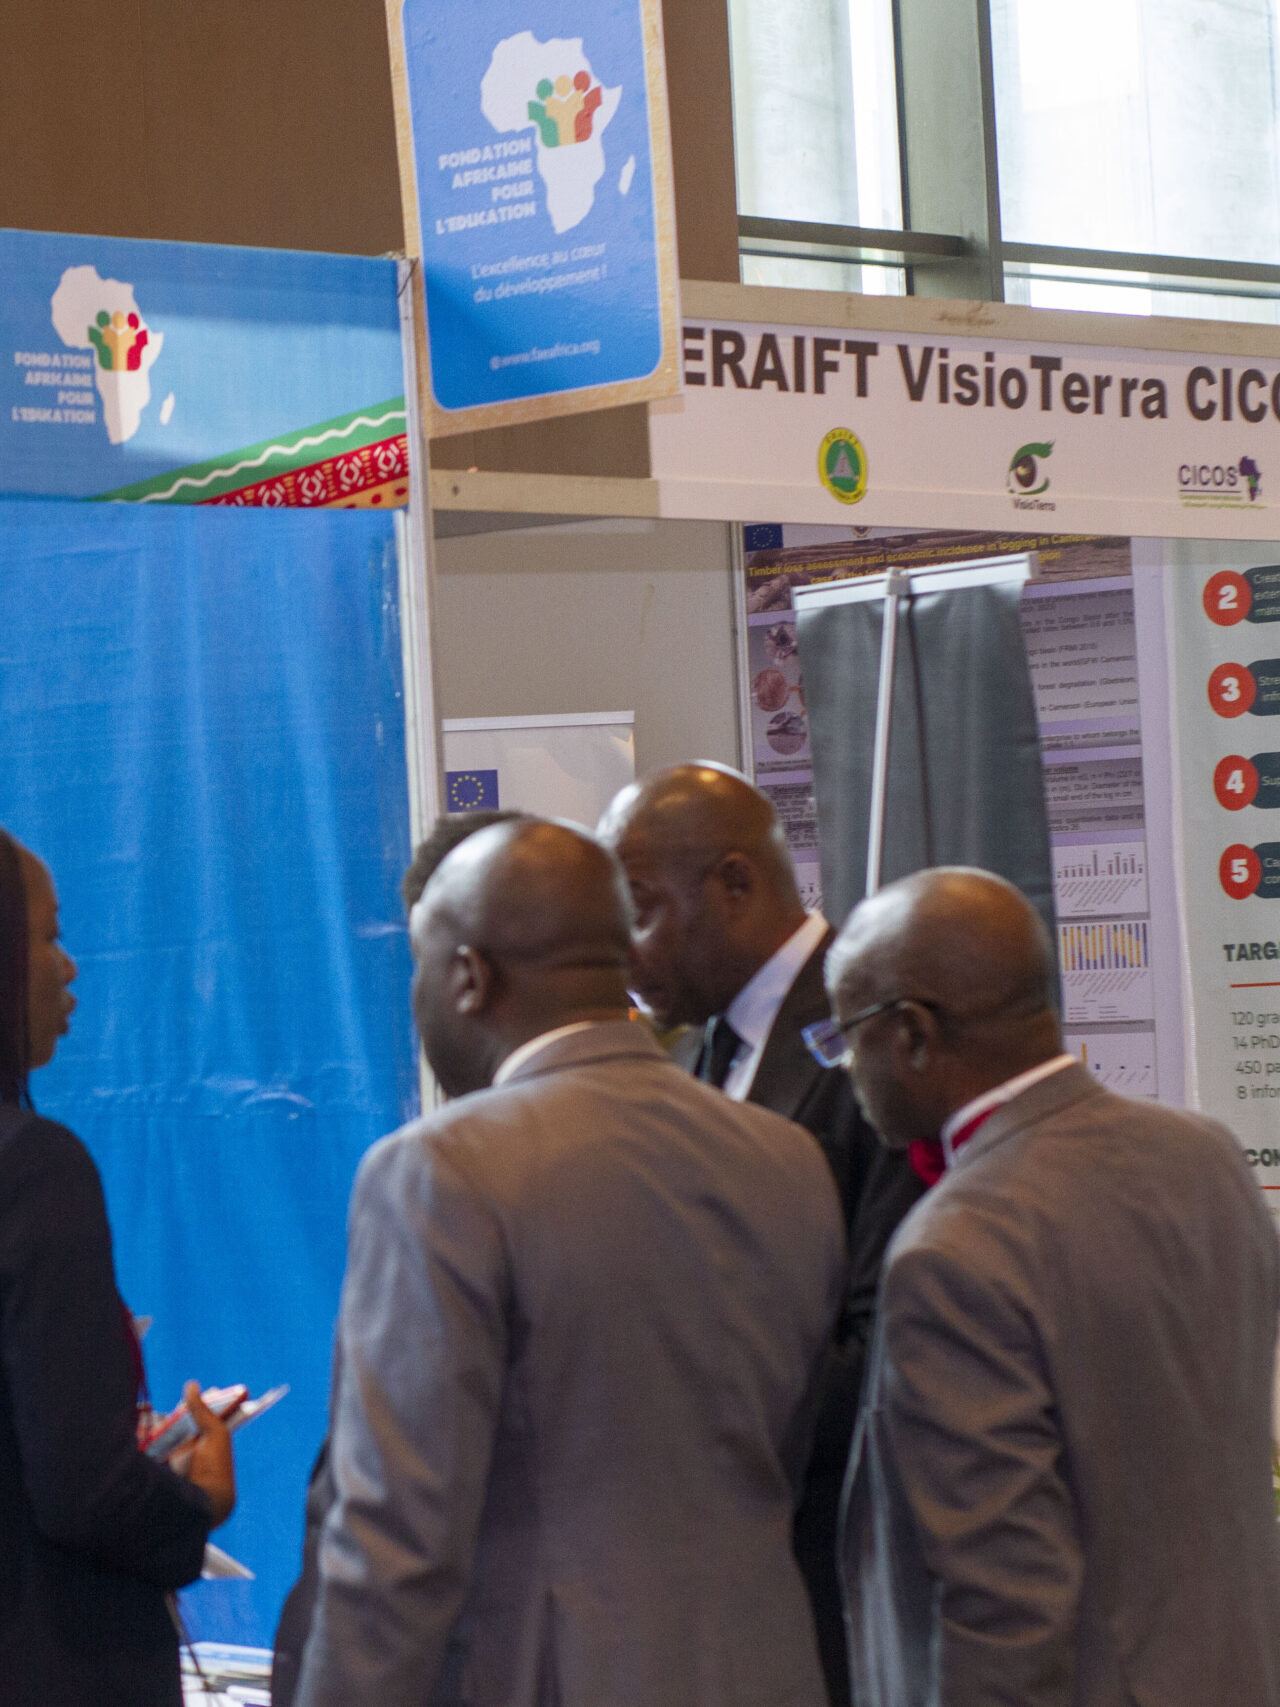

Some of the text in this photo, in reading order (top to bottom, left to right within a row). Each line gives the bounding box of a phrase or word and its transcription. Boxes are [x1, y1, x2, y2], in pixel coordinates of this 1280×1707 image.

[438, 137, 532, 170] FONDATION
[452, 158, 533, 189] AFRICAINE
[491, 180, 534, 202] POUR
[471, 253, 550, 280] L'excellence
[552, 250, 568, 265] au
[474, 285, 492, 303] du
[494, 266, 600, 300] développement
[14, 351, 91, 369] FONDATION
[24, 370, 93, 387] AFRICAINE
[682, 326, 879, 398] ERAIFT
[897, 343, 1168, 420] VisioTerra
[57, 390, 95, 405] POUR
[1178, 464, 1238, 487] CICOS
[748, 566, 781, 577] Timber
[784, 564, 803, 574] loss
[807, 556, 864, 571] assessment
[867, 553, 884, 564] and
[887, 547, 936, 562] economic
[987, 542, 997, 551] in
[999, 538, 1037, 551] logging
[1039, 536, 1049, 545] in
[1218, 585, 1239, 610] 2
[1221, 677, 1241, 702] 3
[1226, 769, 1246, 794] 4
[1230, 859, 1250, 884] 5
[1231, 1011, 1255, 1026] 120
[1232, 1034, 1280, 1050] 14 PhD
[1235, 1060, 1262, 1075] 450
[1236, 1085, 1247, 1100] 8
